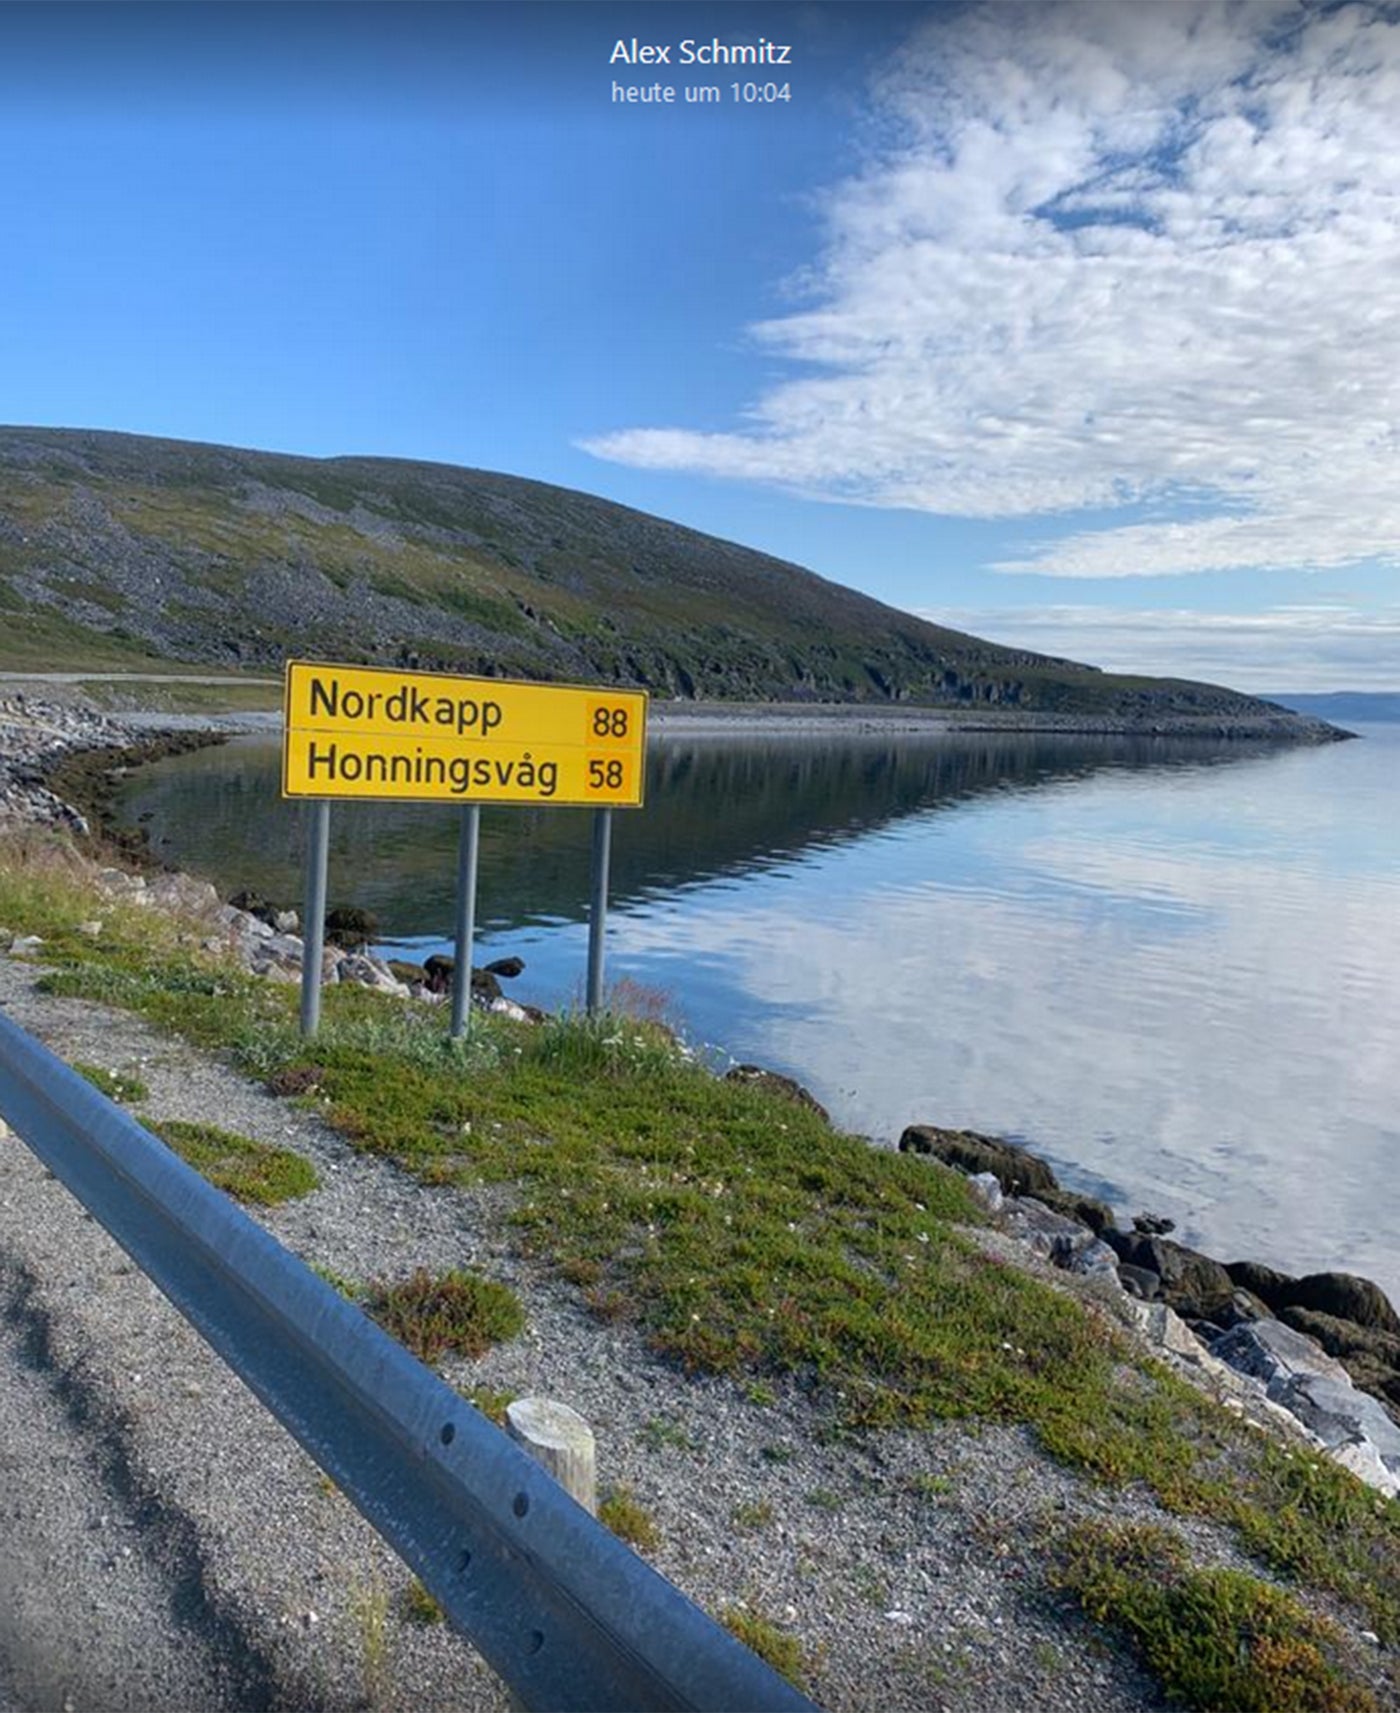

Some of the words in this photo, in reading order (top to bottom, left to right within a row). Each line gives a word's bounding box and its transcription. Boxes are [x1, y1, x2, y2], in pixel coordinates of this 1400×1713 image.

[310, 678, 503, 736] Nordkapp
[593, 707, 629, 738] 88
[308, 742, 558, 796] Honningsvåg
[588, 760, 624, 789] 58
